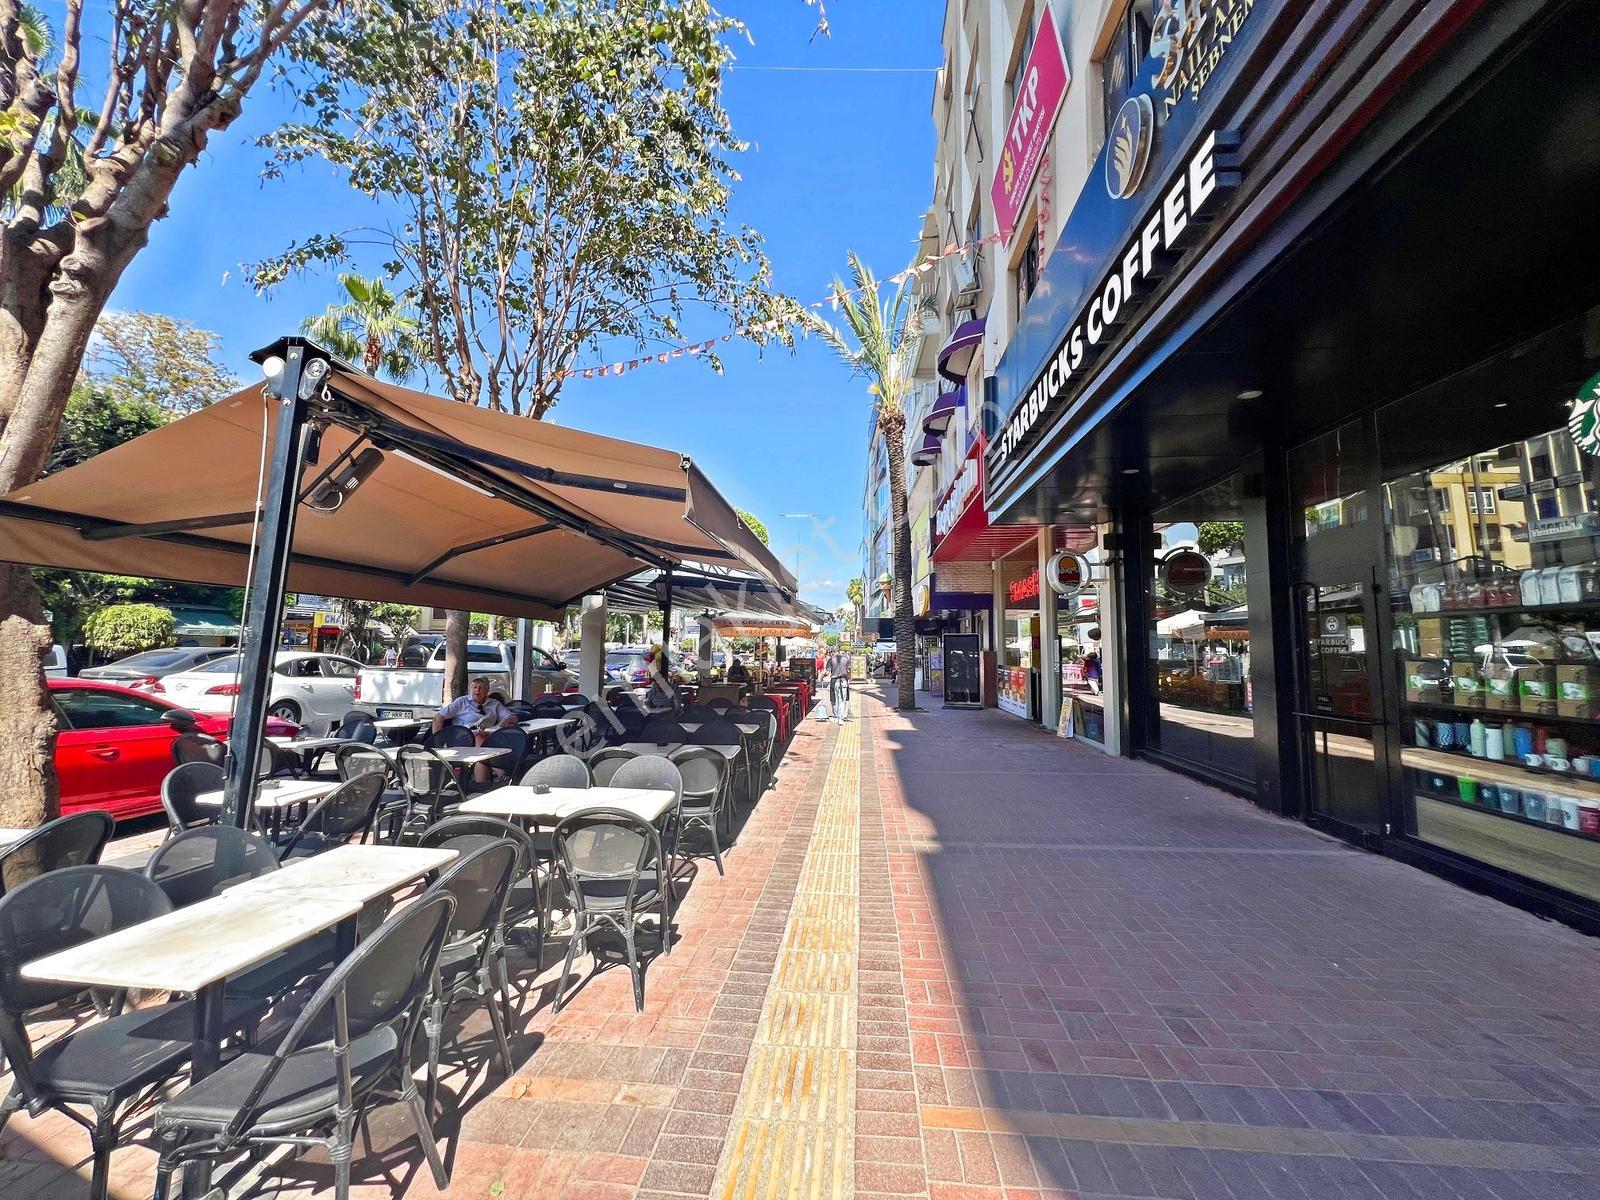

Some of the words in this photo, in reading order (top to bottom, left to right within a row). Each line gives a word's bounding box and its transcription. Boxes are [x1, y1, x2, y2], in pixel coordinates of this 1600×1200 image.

[1011, 66, 1039, 152] TKP
[1164, 43, 1208, 120] NAIL
[1000, 324, 1084, 461] STARBUCKS
[1087, 129, 1217, 345] COFFEE
